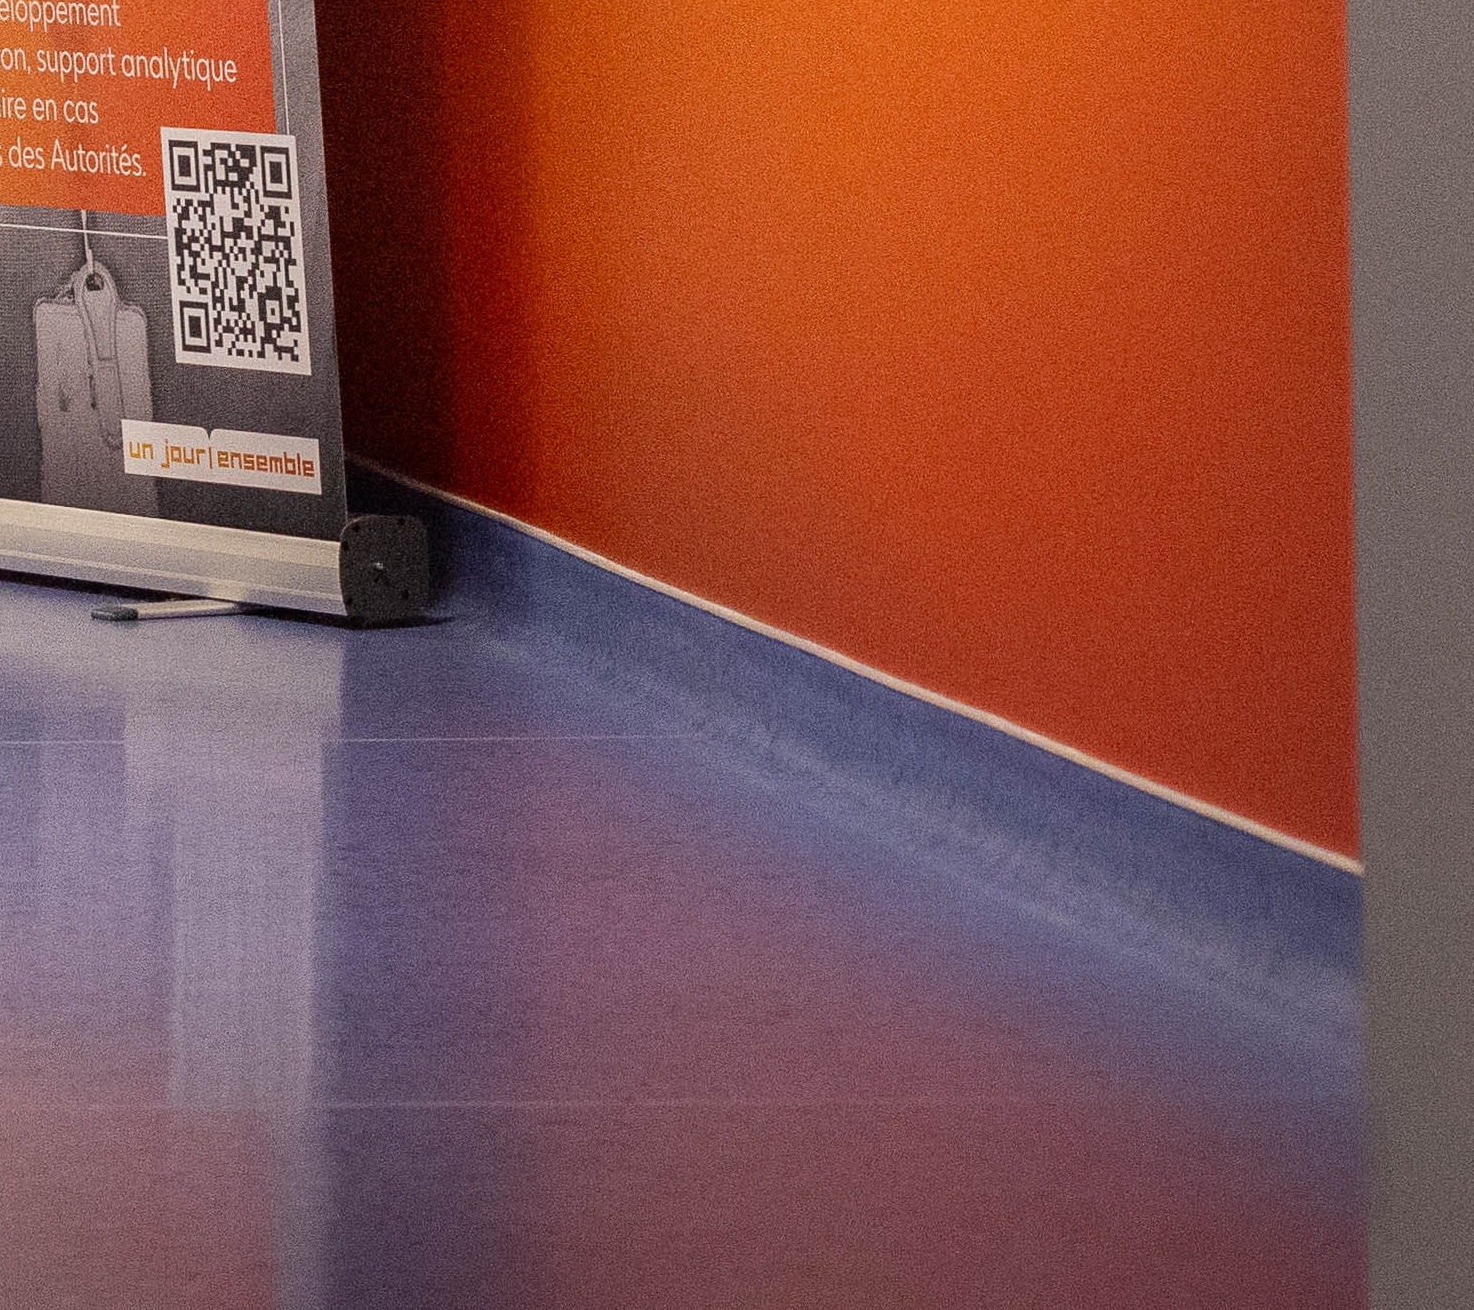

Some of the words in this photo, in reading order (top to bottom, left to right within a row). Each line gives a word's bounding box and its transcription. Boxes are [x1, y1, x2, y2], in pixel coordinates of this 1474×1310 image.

[37, 47, 116, 82] support
[121, 48, 237, 90] analytique
[32, 98, 57, 120] en
[62, 101, 98, 123] cas
[8, 137, 45, 169] des
[50, 139, 146, 177] Autorités.
[128, 441, 154, 459] un
[160, 438, 205, 468] jour
[218, 438, 314, 477] ensemble
